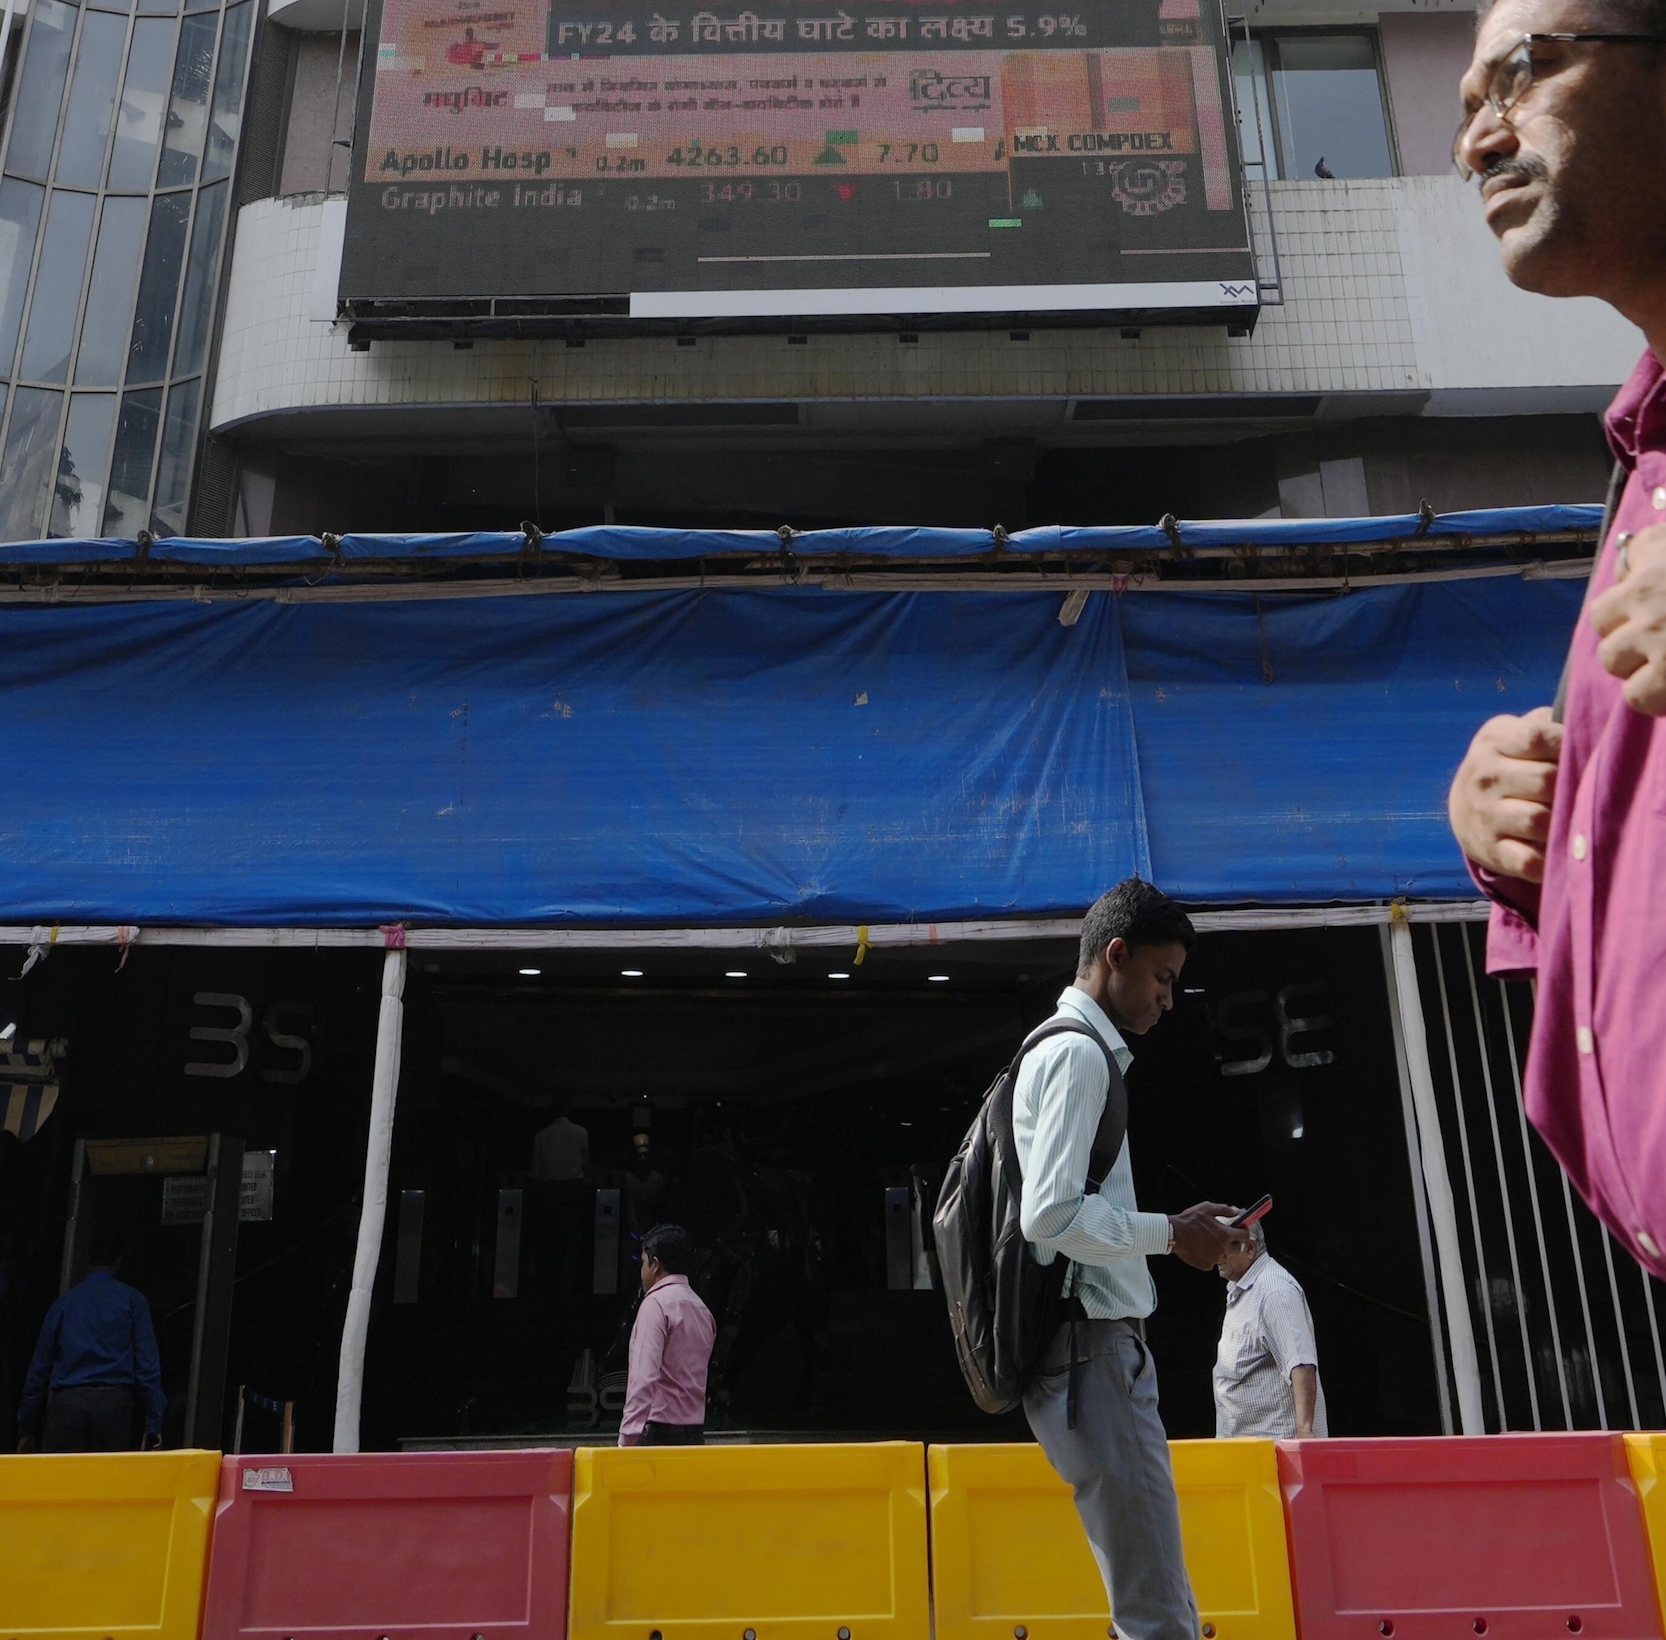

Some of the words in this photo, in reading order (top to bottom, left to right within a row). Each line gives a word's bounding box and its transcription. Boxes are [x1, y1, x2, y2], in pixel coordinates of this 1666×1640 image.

[558, 21, 637, 45] FY24
[647, 12, 680, 43] के
[796, 10, 858, 40] घाटे
[865, 15, 911, 39] का
[1006, 14, 1087, 38] 5.9%
[379, 147, 469, 176] Apollo
[482, 145, 550, 175] Hosp
[666, 145, 788, 166] 4263.60
[877, 143, 939, 164] 7.70
[1014, 134, 1060, 152] MCX
[382, 184, 500, 215] Graphite
[513, 182, 582, 207] India
